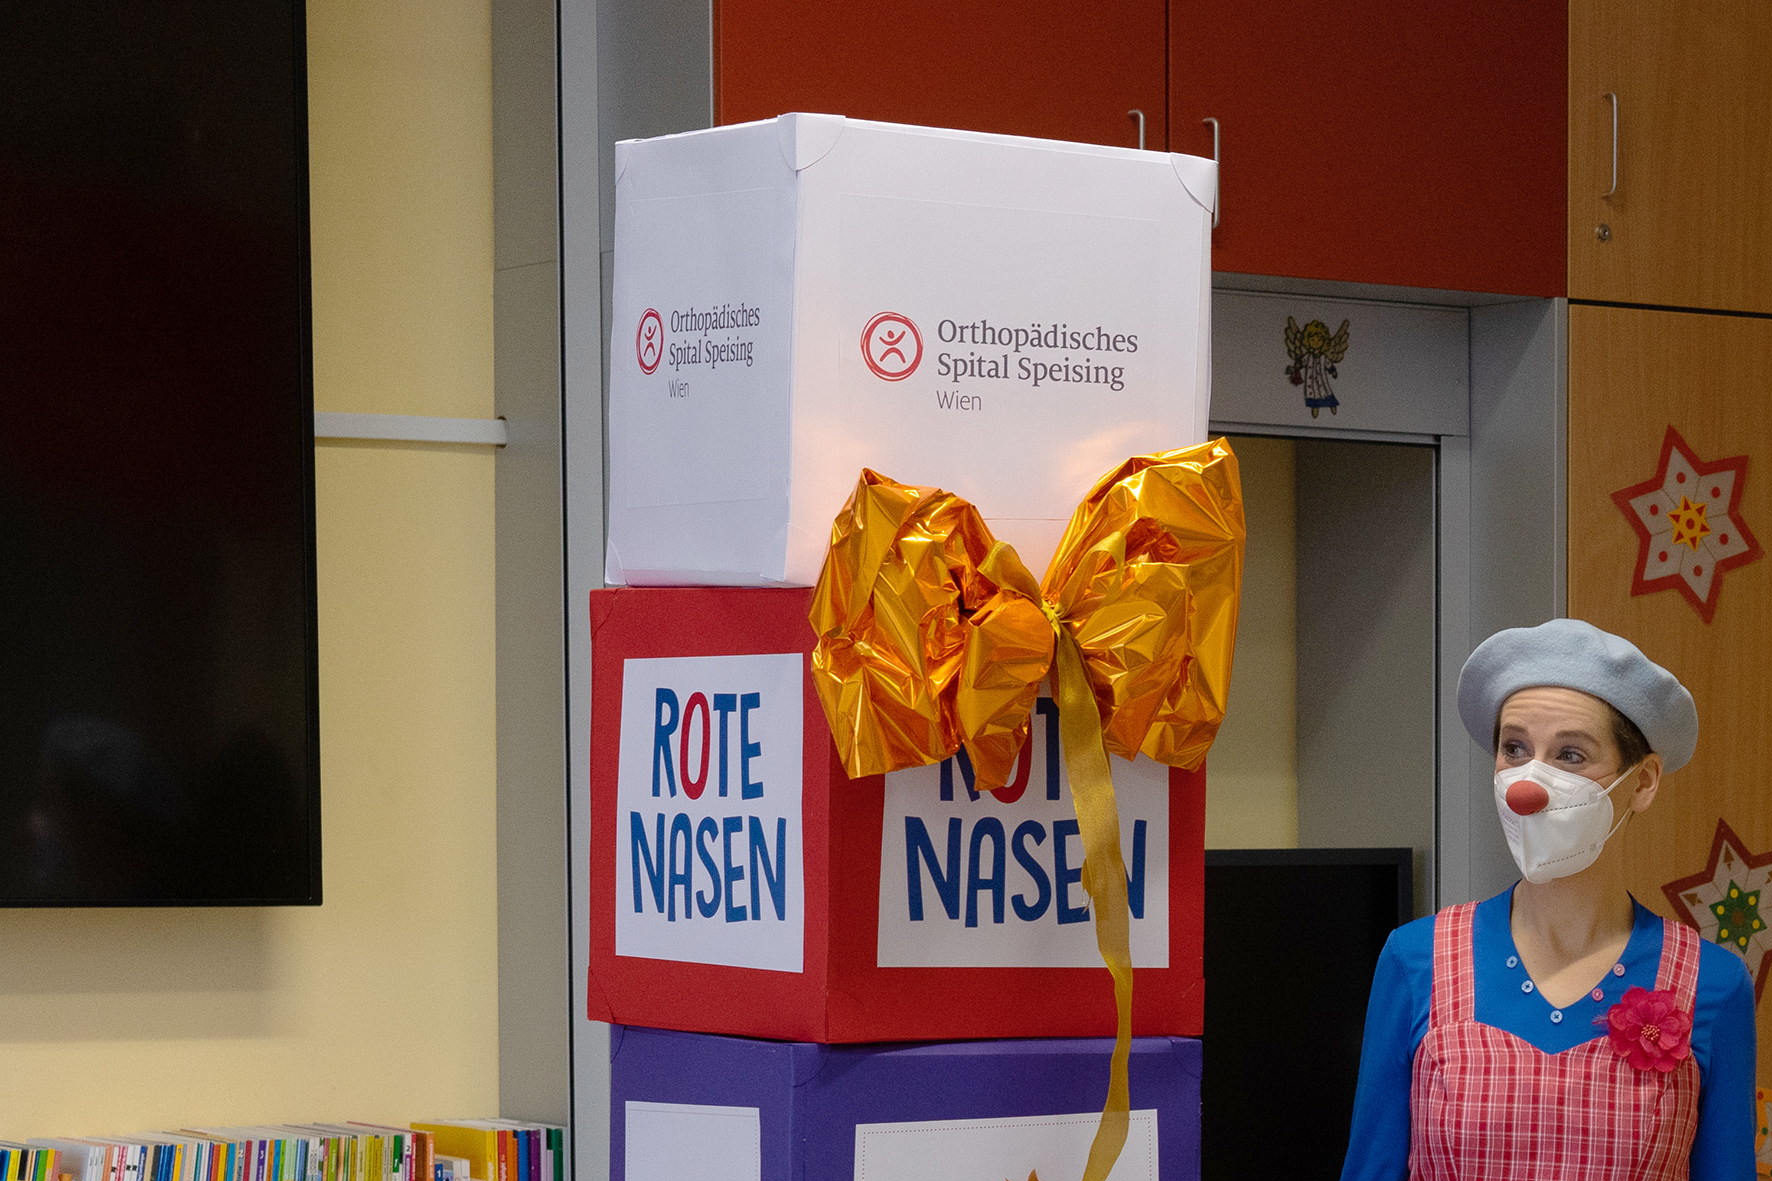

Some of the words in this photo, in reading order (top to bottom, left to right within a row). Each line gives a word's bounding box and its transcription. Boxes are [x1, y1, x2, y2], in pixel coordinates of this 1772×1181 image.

[670, 302, 760, 336] Orthopädisches
[669, 341, 702, 370] Spital
[705, 337, 754, 369] Speising
[937, 319, 1139, 355] Orthopädisches
[668, 378, 690, 398] Wien
[937, 353, 1009, 382] Spital
[1017, 356, 1125, 392] Speising
[936, 390, 982, 412] Wien
[652, 688, 764, 801] ROTE
[630, 810, 787, 924] NASEN
